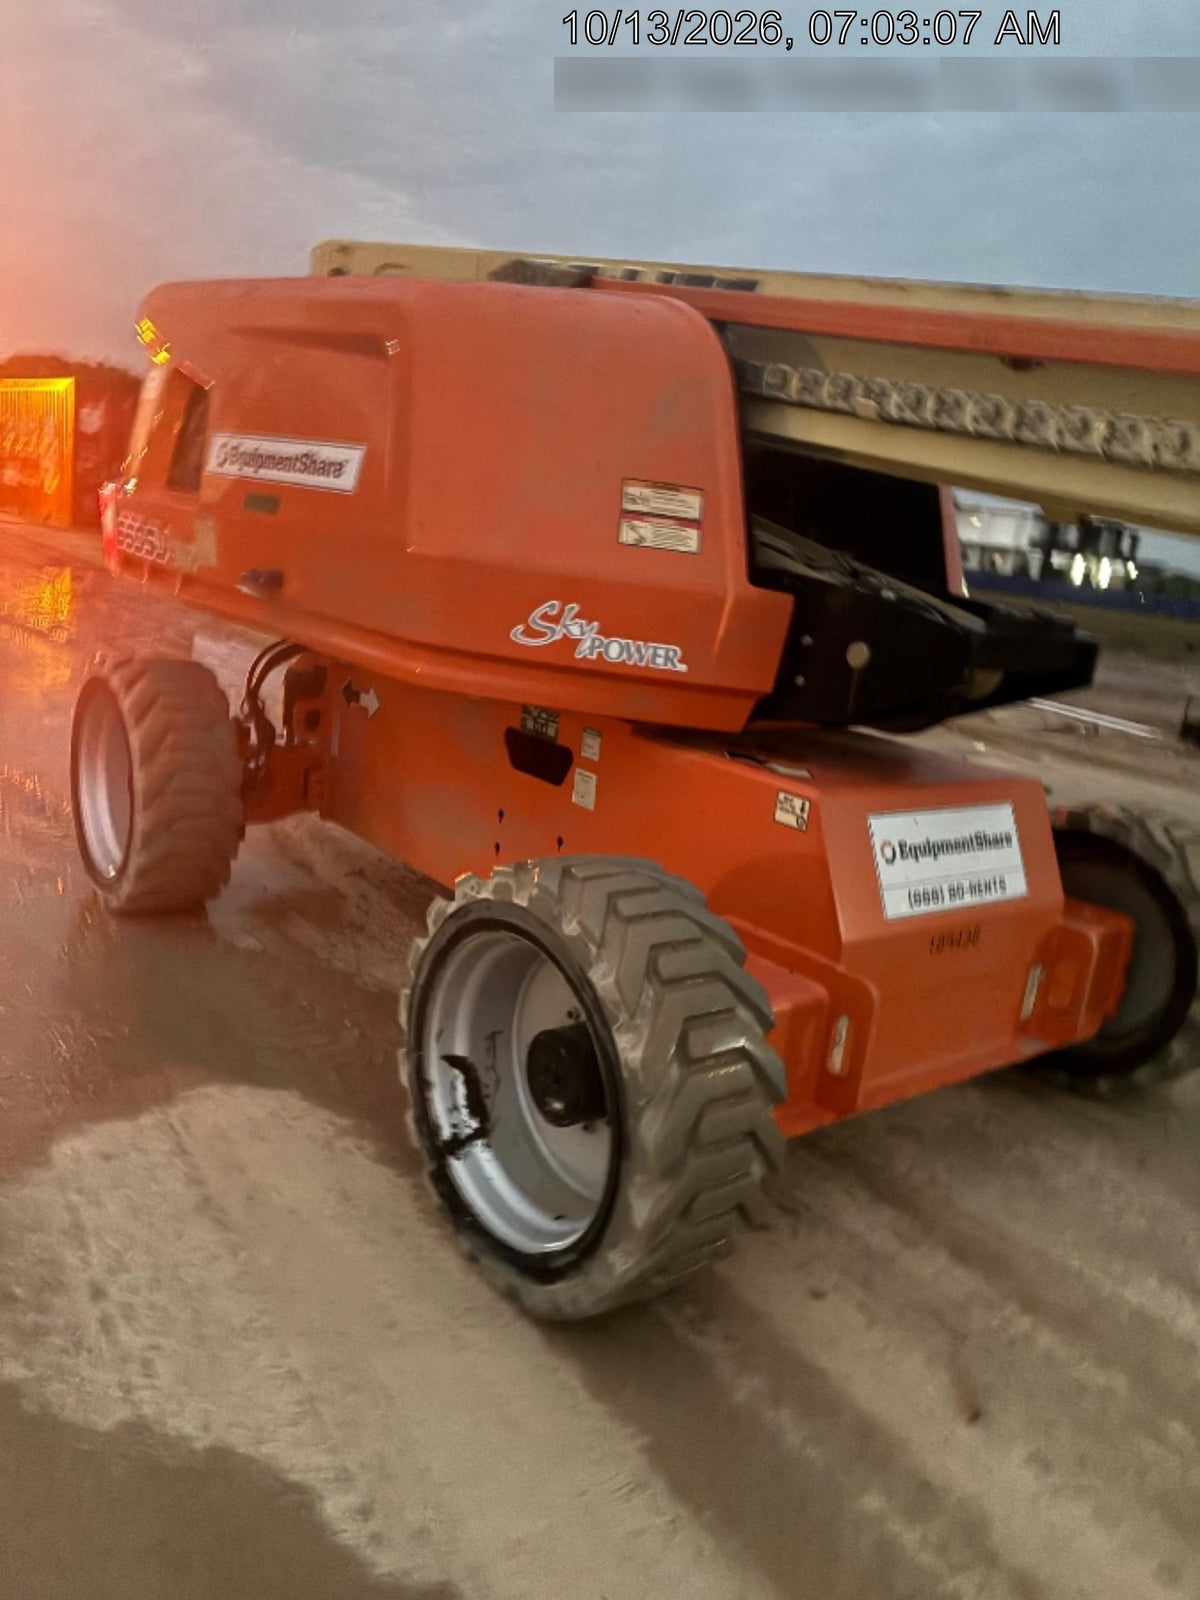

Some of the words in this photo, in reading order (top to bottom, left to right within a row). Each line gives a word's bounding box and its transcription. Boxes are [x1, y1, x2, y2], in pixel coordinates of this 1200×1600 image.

[227, 445, 345, 478] EquipmentShare
[510, 600, 598, 658] Sky
[588, 636, 688, 672] POWER
[898, 831, 1013, 863] EquipmentShare
